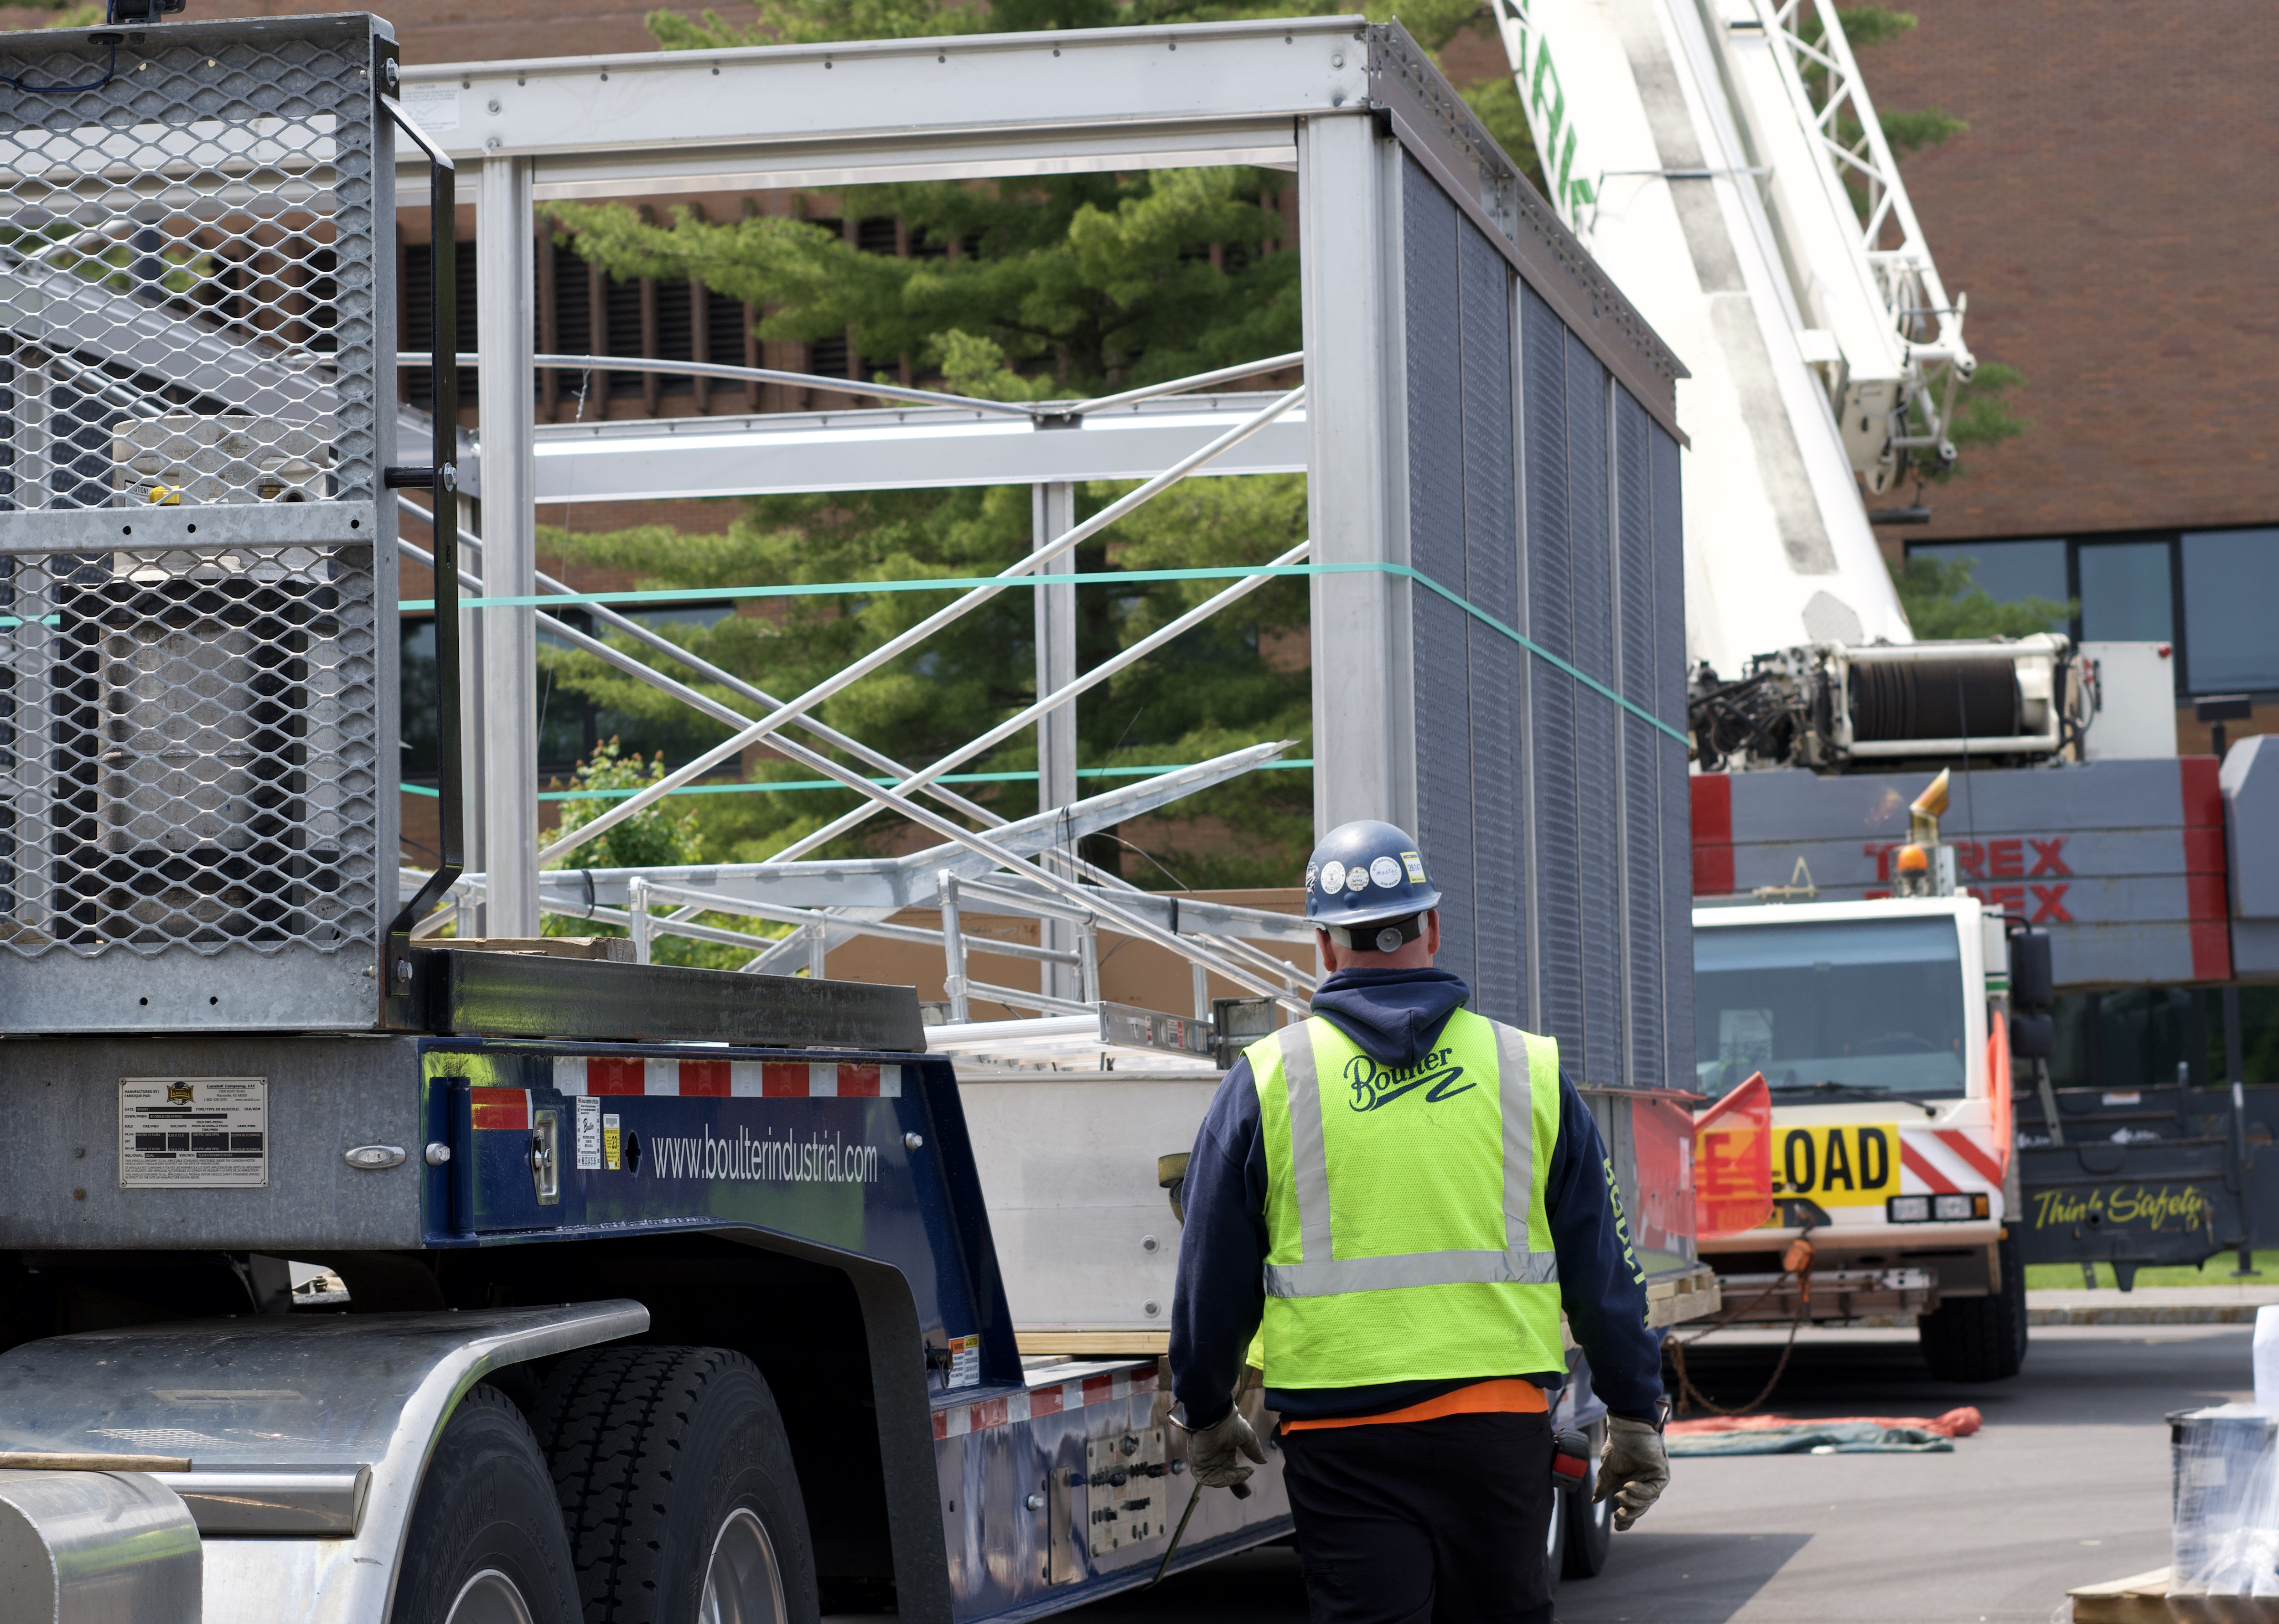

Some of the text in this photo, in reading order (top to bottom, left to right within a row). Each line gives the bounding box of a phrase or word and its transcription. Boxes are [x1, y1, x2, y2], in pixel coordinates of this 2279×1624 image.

[1862, 837, 2073, 881] TREX
[652, 1123, 877, 1182] www.boulterindustrial.com
[2107, 1183, 2203, 1231] Safety
